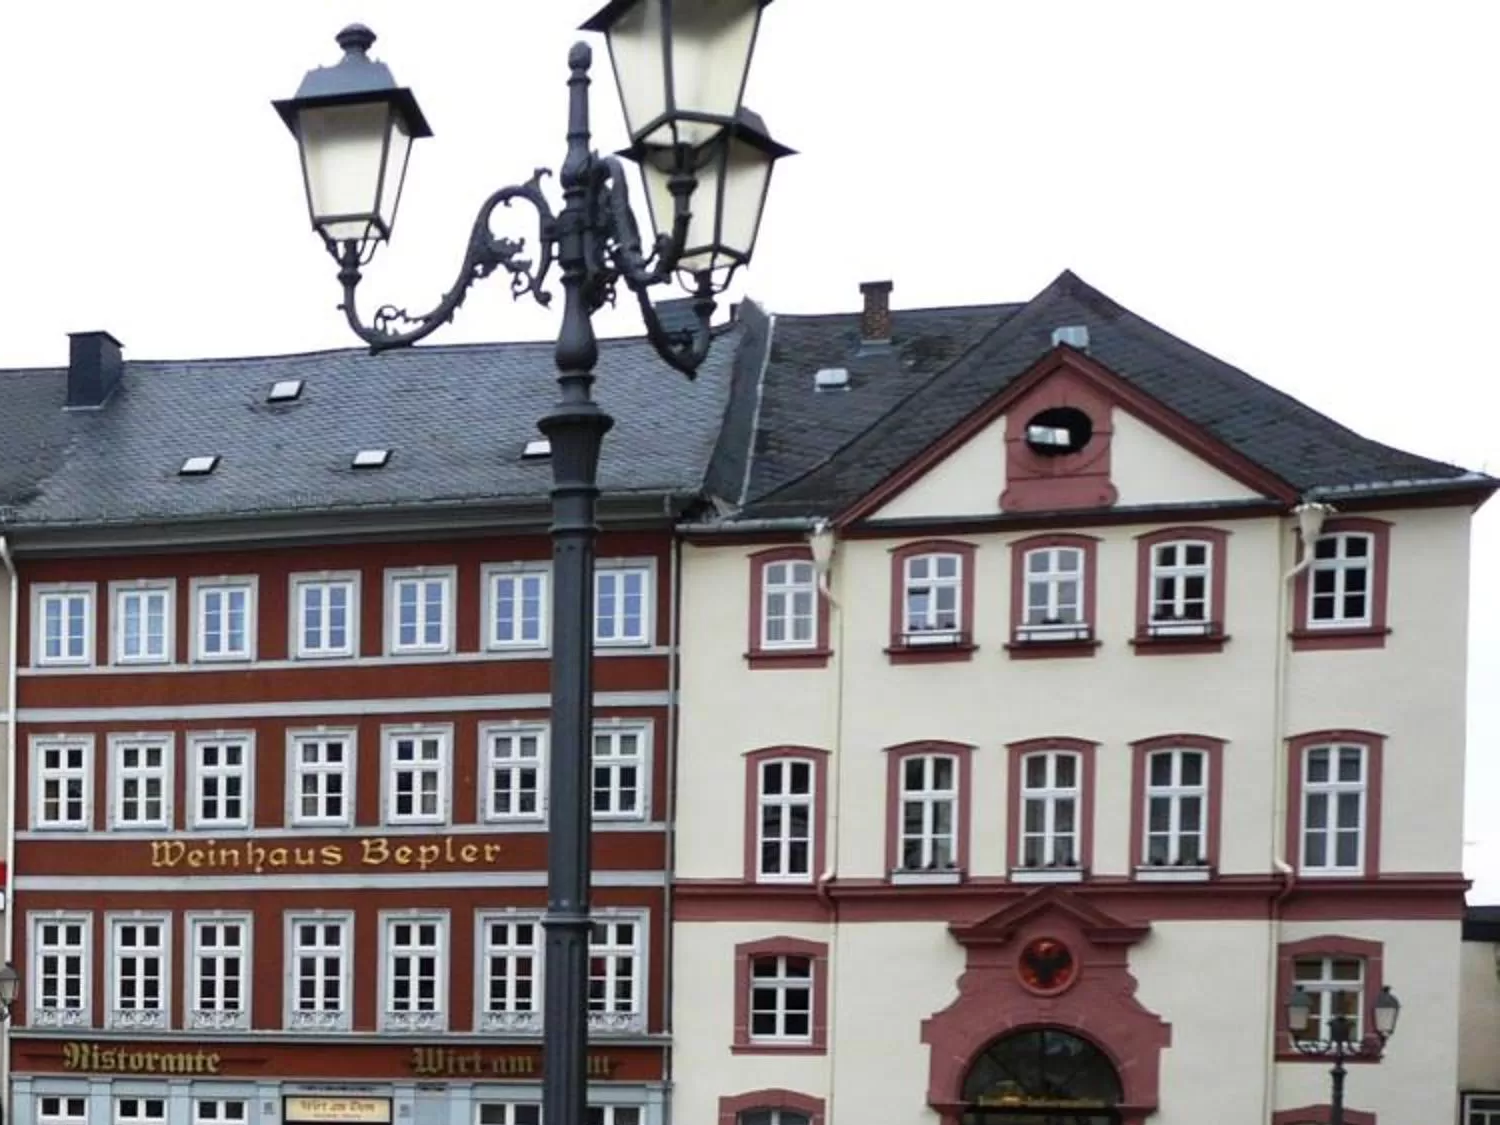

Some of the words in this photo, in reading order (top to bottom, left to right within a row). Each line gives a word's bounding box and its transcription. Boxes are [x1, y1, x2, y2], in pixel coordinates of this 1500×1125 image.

[150, 840, 343, 873] Weinhaus
[361, 837, 501, 870] Bepler
[63, 1041, 220, 1073] Ristorante
[412, 1047, 482, 1074] Wirt
[493, 1055, 533, 1073] am
